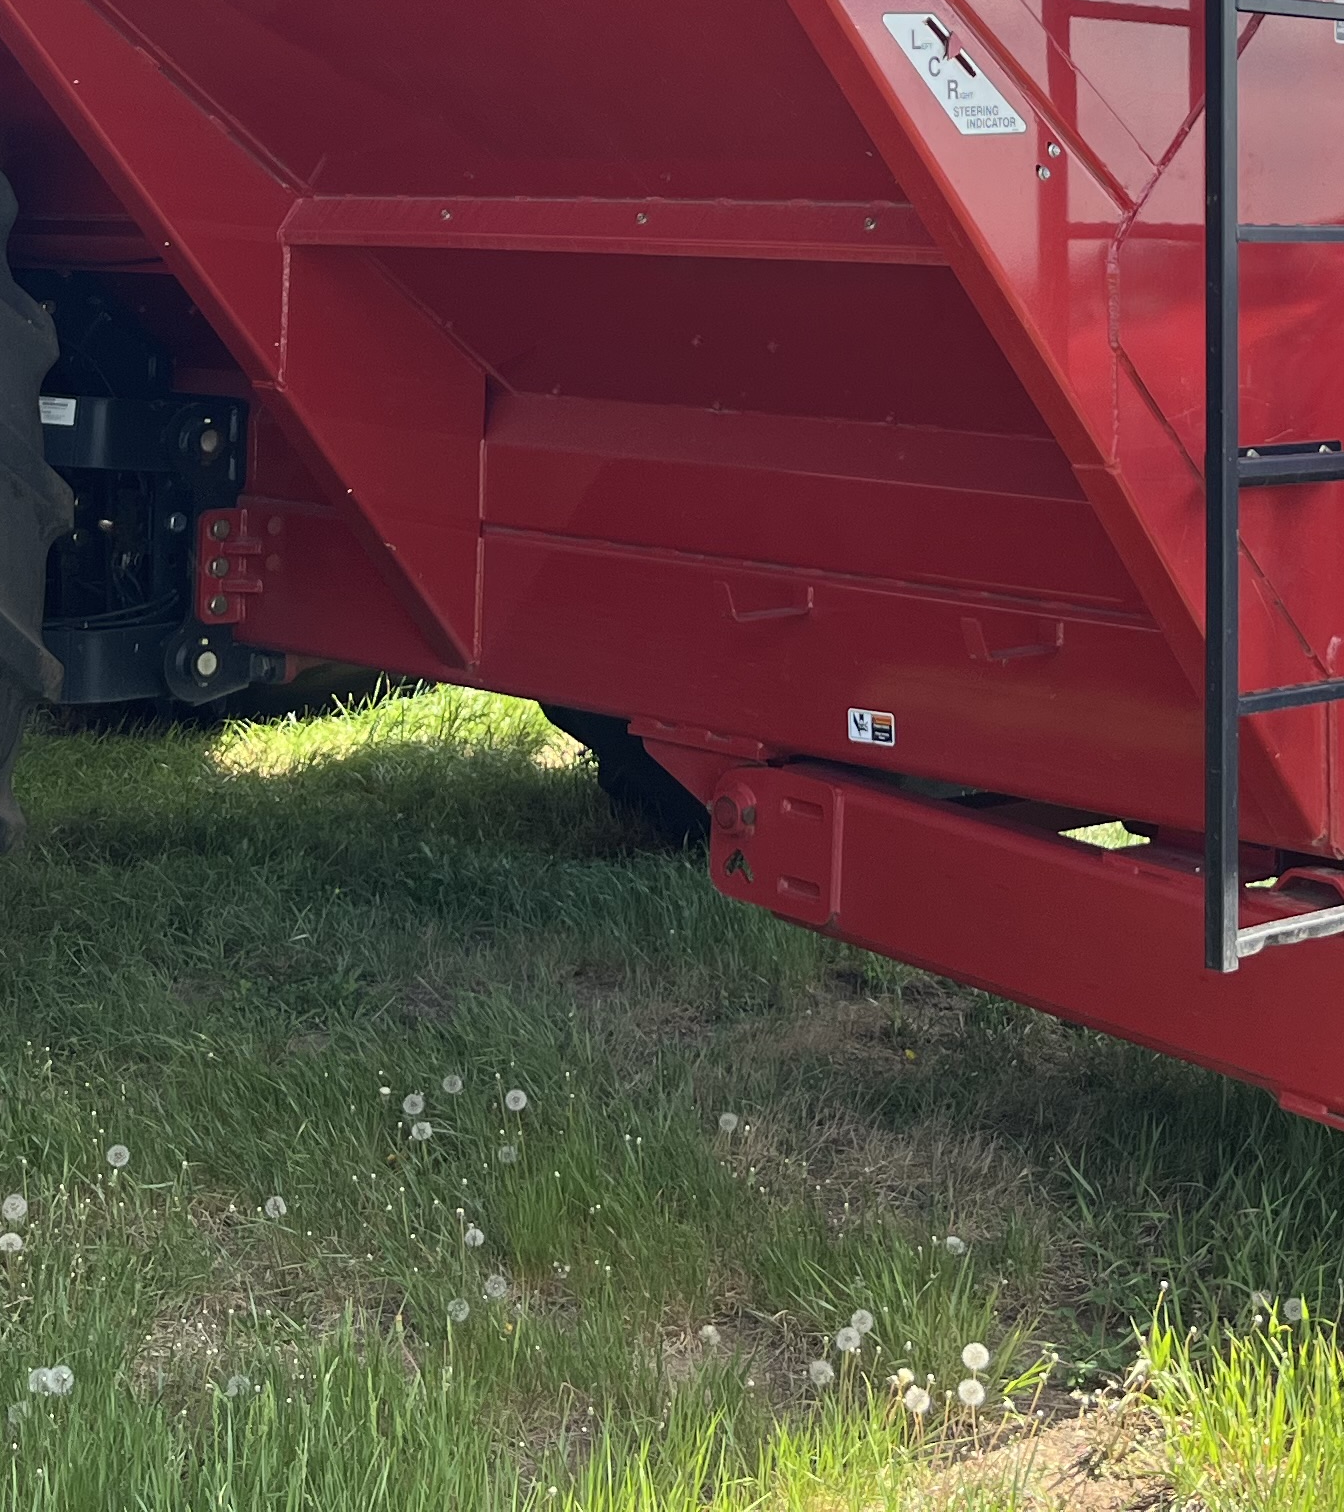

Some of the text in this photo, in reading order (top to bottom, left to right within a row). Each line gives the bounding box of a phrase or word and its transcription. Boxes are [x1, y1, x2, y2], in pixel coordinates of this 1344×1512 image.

[928, 56, 941, 77] C
[953, 105, 999, 118] STEERING
[966, 117, 1017, 129] INDICATOR
